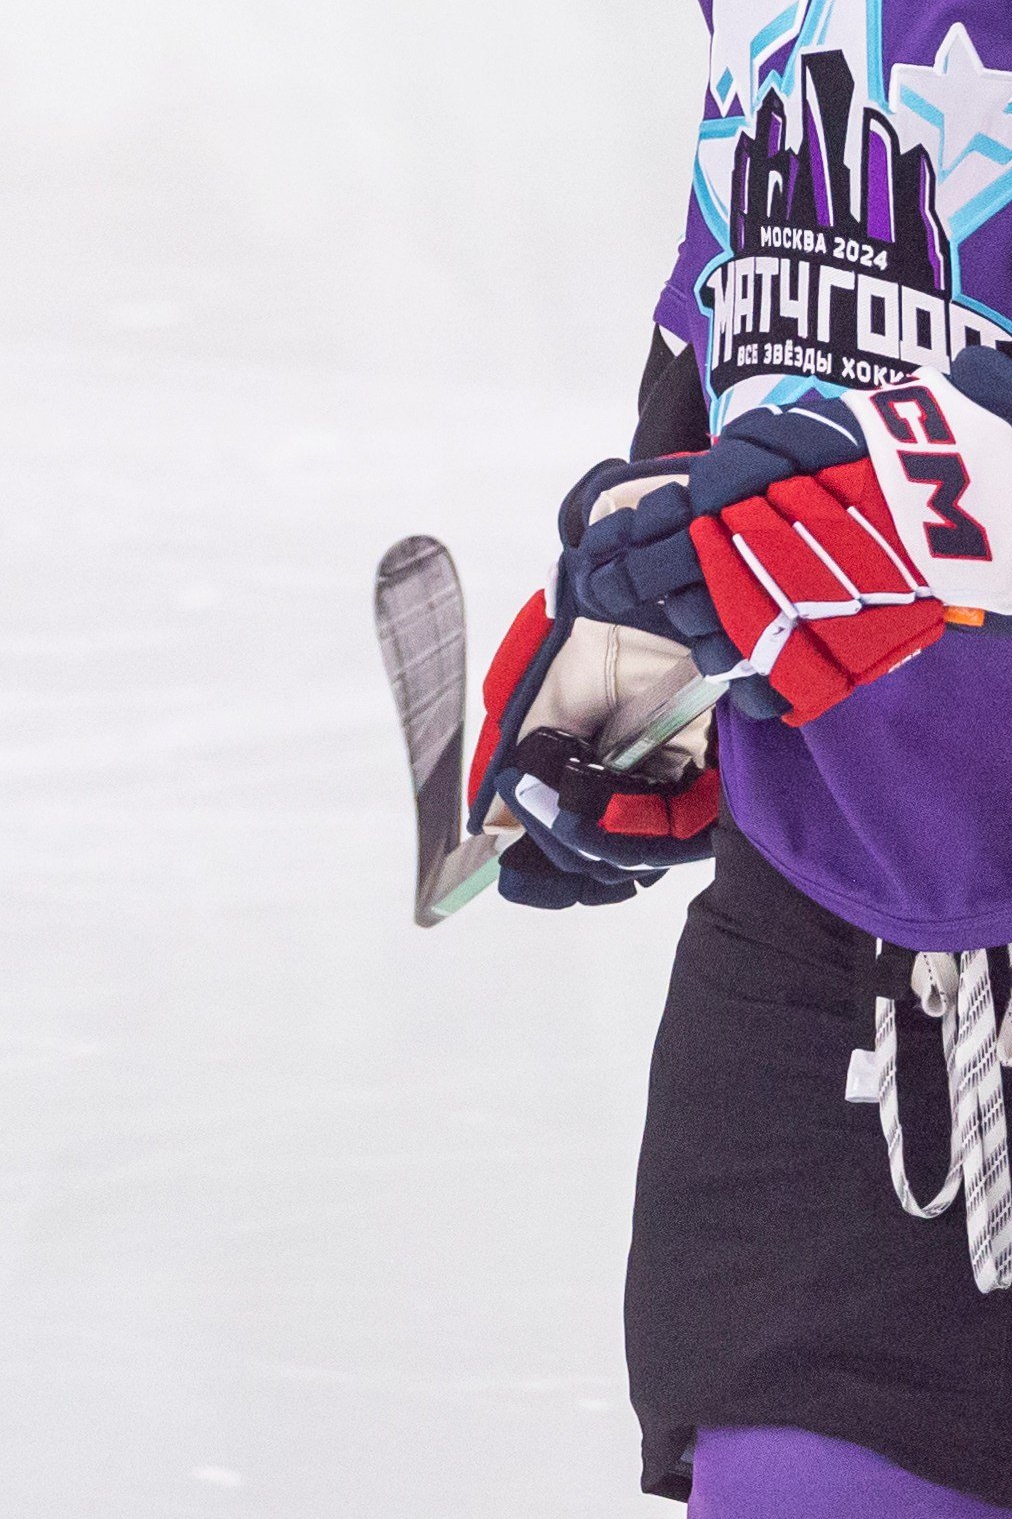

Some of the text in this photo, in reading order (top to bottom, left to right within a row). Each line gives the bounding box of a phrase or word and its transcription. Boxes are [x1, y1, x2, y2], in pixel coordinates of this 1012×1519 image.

[760, 225, 888, 271] МОСКВА 2024
[737, 343, 759, 367] ВСЕ
[763, 339, 832, 375] ЗВЁЗДЫ
[869, 381, 992, 562] CM
